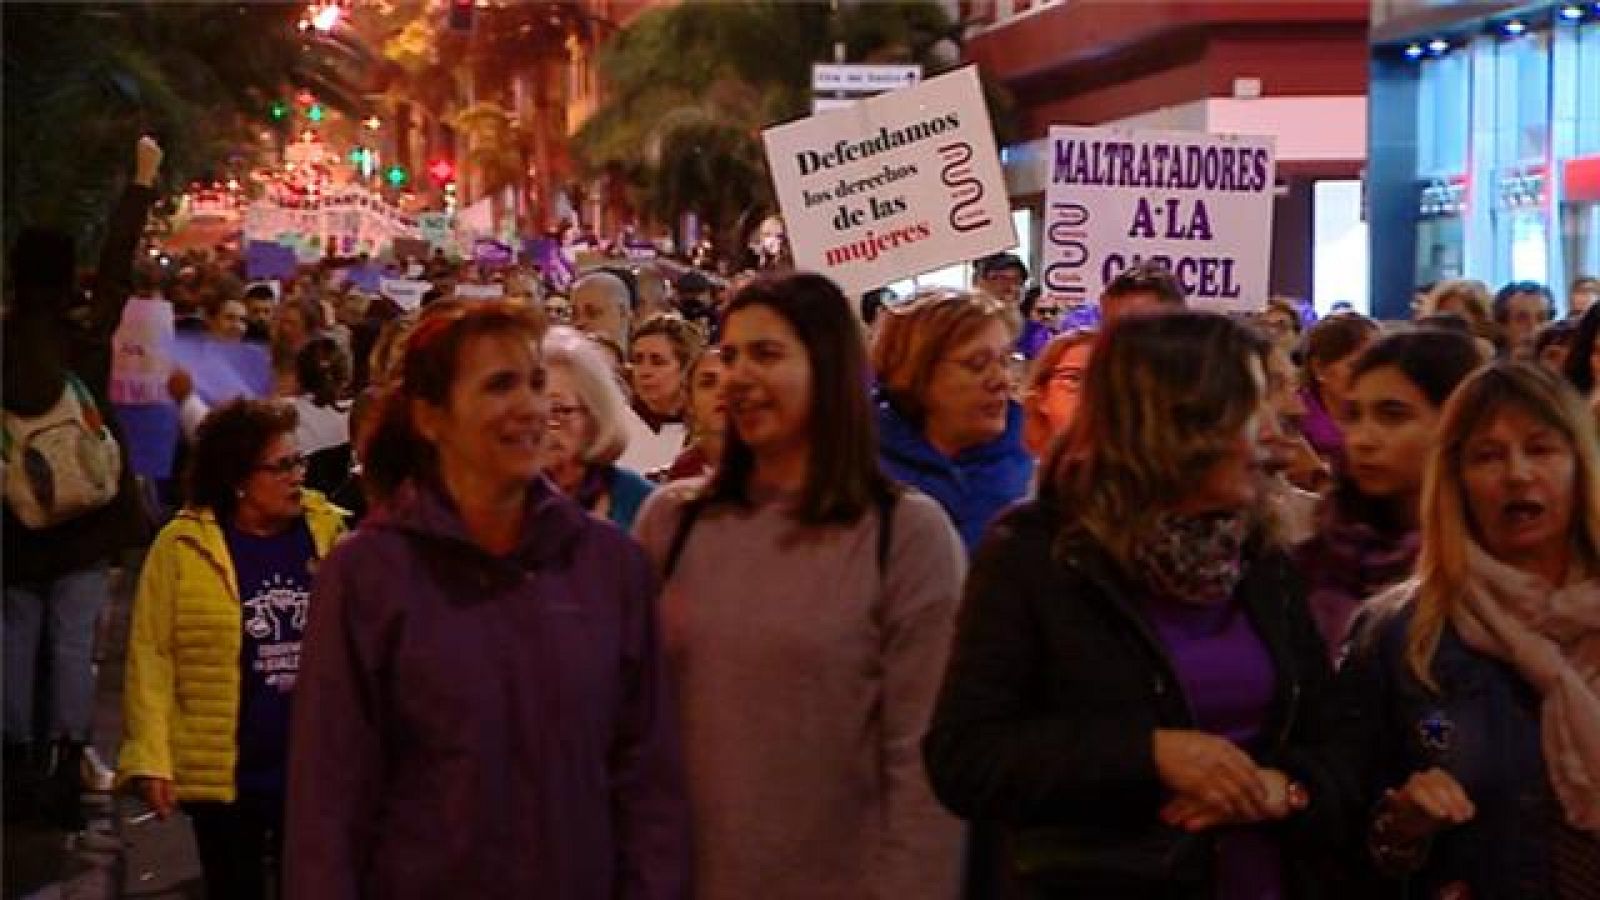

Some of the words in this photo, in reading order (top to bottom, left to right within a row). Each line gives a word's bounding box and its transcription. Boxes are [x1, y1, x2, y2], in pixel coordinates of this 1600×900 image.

[796, 112, 960, 175] Defendamos
[1053, 140, 1268, 192] MALTRATADORES
[803, 189, 832, 207] los
[834, 163, 918, 199] derechos
[832, 205, 864, 230] de
[869, 195, 907, 220] las
[1128, 197, 1155, 238] A
[1165, 199, 1213, 240] LA
[825, 220, 932, 266] mujeres
